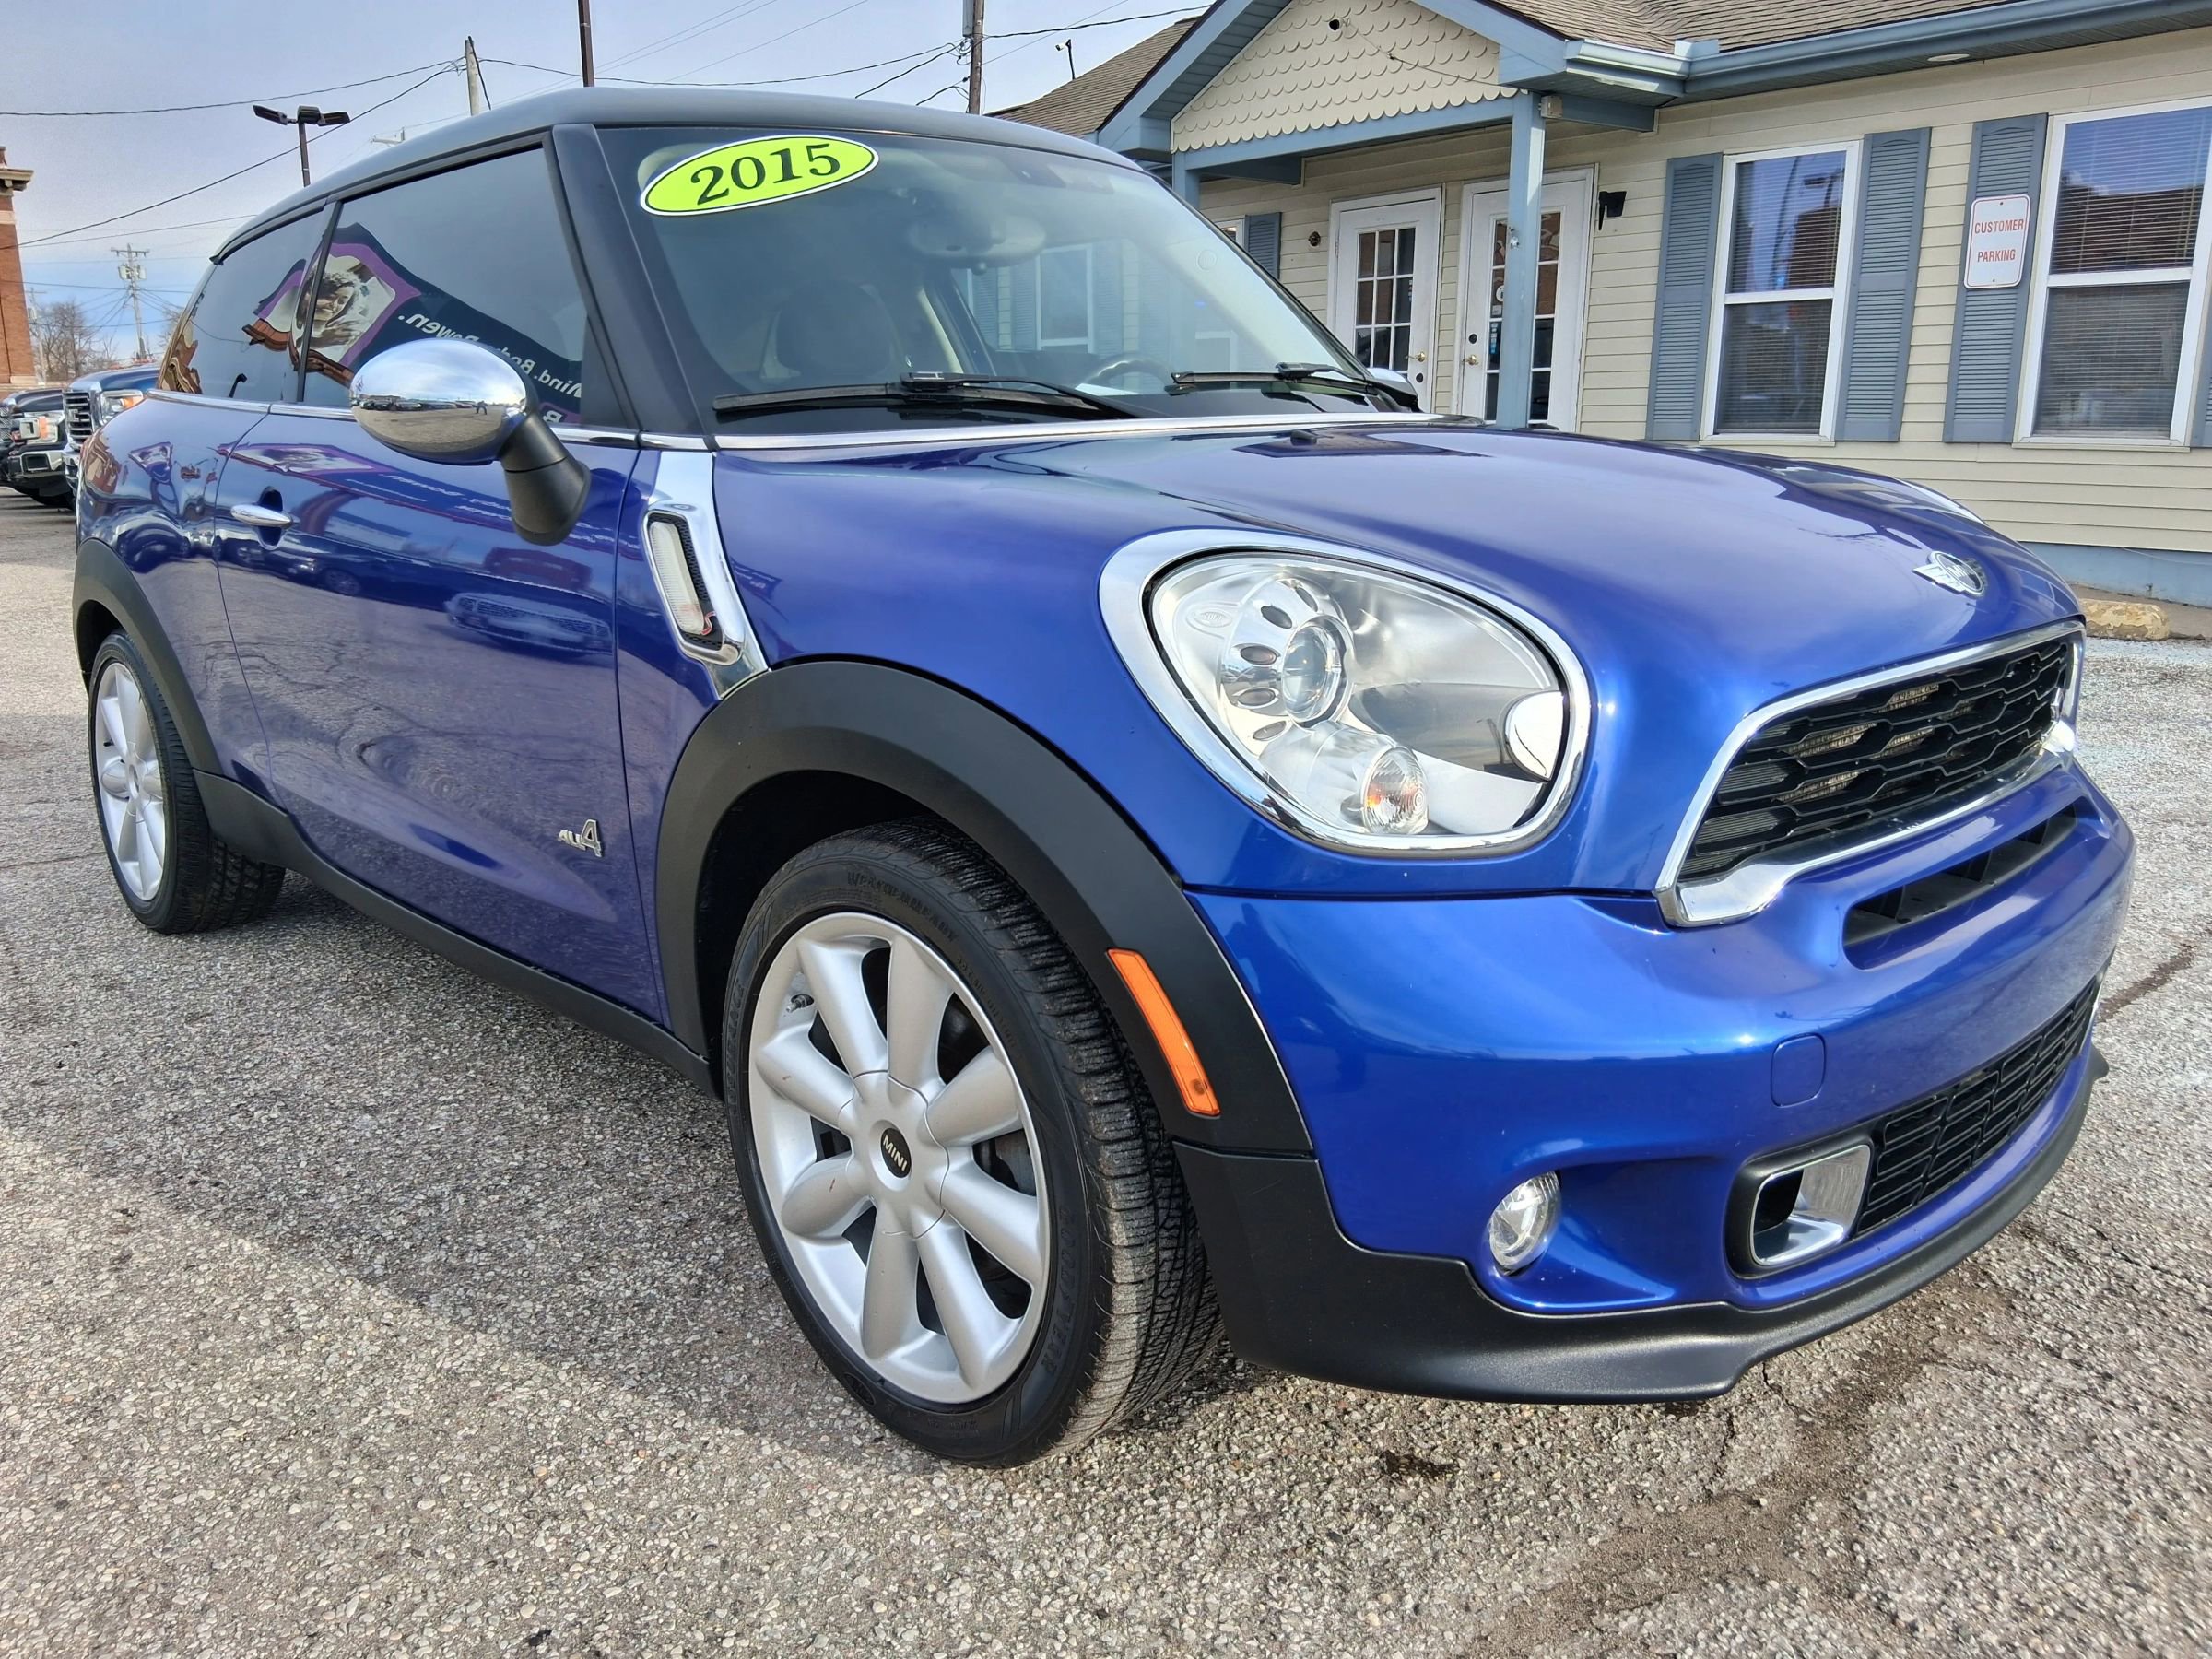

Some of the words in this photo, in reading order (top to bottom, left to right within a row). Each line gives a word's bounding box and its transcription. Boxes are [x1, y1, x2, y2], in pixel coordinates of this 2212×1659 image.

[690, 143, 841, 206] 2015
[1974, 218, 2025, 234] CUSTOMER
[1977, 249, 2017, 263] PARKING
[883, 1135, 908, 1171] MINI
